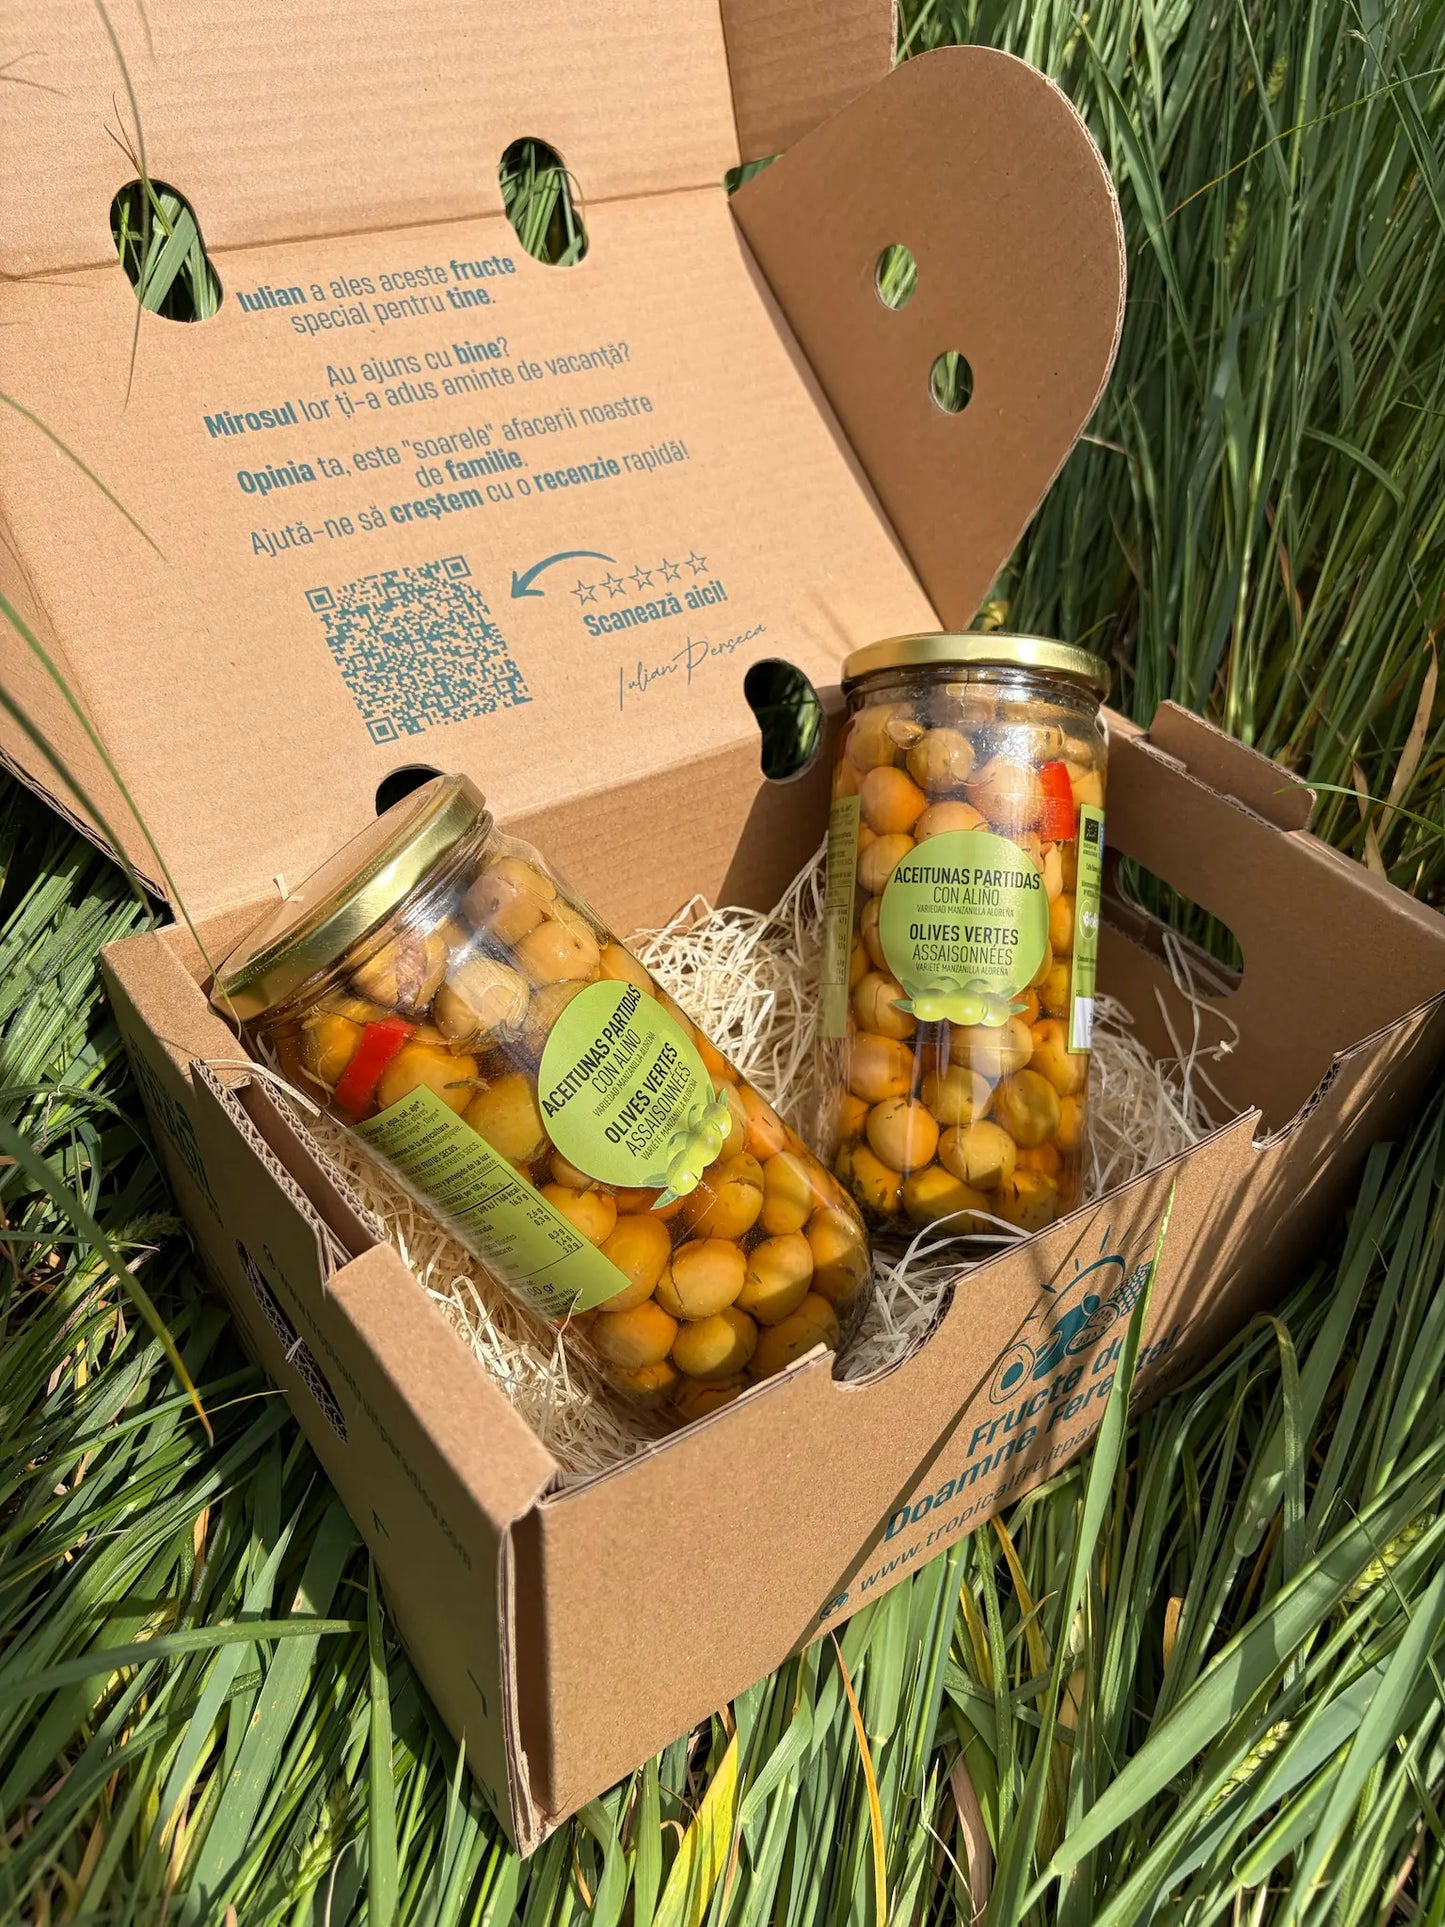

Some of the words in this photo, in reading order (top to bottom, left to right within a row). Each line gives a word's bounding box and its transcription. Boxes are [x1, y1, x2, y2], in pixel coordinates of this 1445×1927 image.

[235, 285, 307, 313] Iulian
[310, 284, 325, 301] a
[329, 276, 376, 299] ales
[379, 265, 448, 291] aceste
[450, 255, 516, 282] fructe
[291, 302, 370, 336] special
[373, 293, 446, 325] pentru
[446, 286, 497, 309] tine.
[326, 365, 357, 388] Au
[360, 355, 421, 384] ajuns
[425, 349, 452, 370] cu
[452, 336, 510, 365] bine?
[203, 401, 299, 439] Mirosul
[298, 399, 329, 422] lor
[384, 381, 439, 407] adus
[444, 364, 515, 396] aminte
[517, 360, 544, 382] de
[544, 341, 632, 376] vacanță?
[236, 460, 316, 497] Opinia
[317, 456, 352, 478] ta,
[352, 445, 402, 471] este
[401, 423, 494, 460] "soarele"
[501, 407, 577, 442] afacerii
[579, 395, 654, 426] noastre
[415, 466, 444, 489] de
[444, 447, 529, 482] familie.
[250, 515, 355, 558] Ajută-ne
[358, 505, 388, 531] să
[390, 485, 485, 521] creștem
[486, 481, 515, 503] cu
[517, 478, 532, 496] o
[532, 455, 621, 492] recenzie
[622, 439, 691, 473] rapidă!
[583, 592, 684, 637] Scanează
[684, 579, 728, 610] aici!
[619, 661, 678, 711] Iulian
[894, 866, 970, 885] ACEITUNAS
[974, 868, 1040, 890] PARTIDAS
[933, 886, 960, 904] CON
[963, 886, 1000, 906] ALIÑO
[909, 923, 960, 942] OLIVES
[965, 925, 1019, 946] VERTES
[916, 904, 946, 914] VARIEDAD
[948, 905, 985, 916] MANZANILLA
[912, 943, 1013, 966] ASSAISONNÉES
[942, 963, 979, 975] MANZANILLA
[540, 1038, 610, 1118] ACEITUNAS
[602, 983, 642, 1046] PARTIDAS
[591, 1061, 620, 1094] CON
[613, 1028, 642, 1069] ALIÑO
[592, 1087, 620, 1117] VARIEDAD
[617, 1054, 643, 1089] MANZANILLA
[604, 1089, 650, 1144] OLIVES
[643, 1042, 678, 1095] VERTES
[625, 1062, 692, 1157] ASSAISONNÉES
[660, 1101, 686, 1138] MANZANILLA
[543, 1283, 555, 1294] gr
[966, 1364, 1084, 1458] Fructe
[884, 1425, 1038, 1543] Doamne
